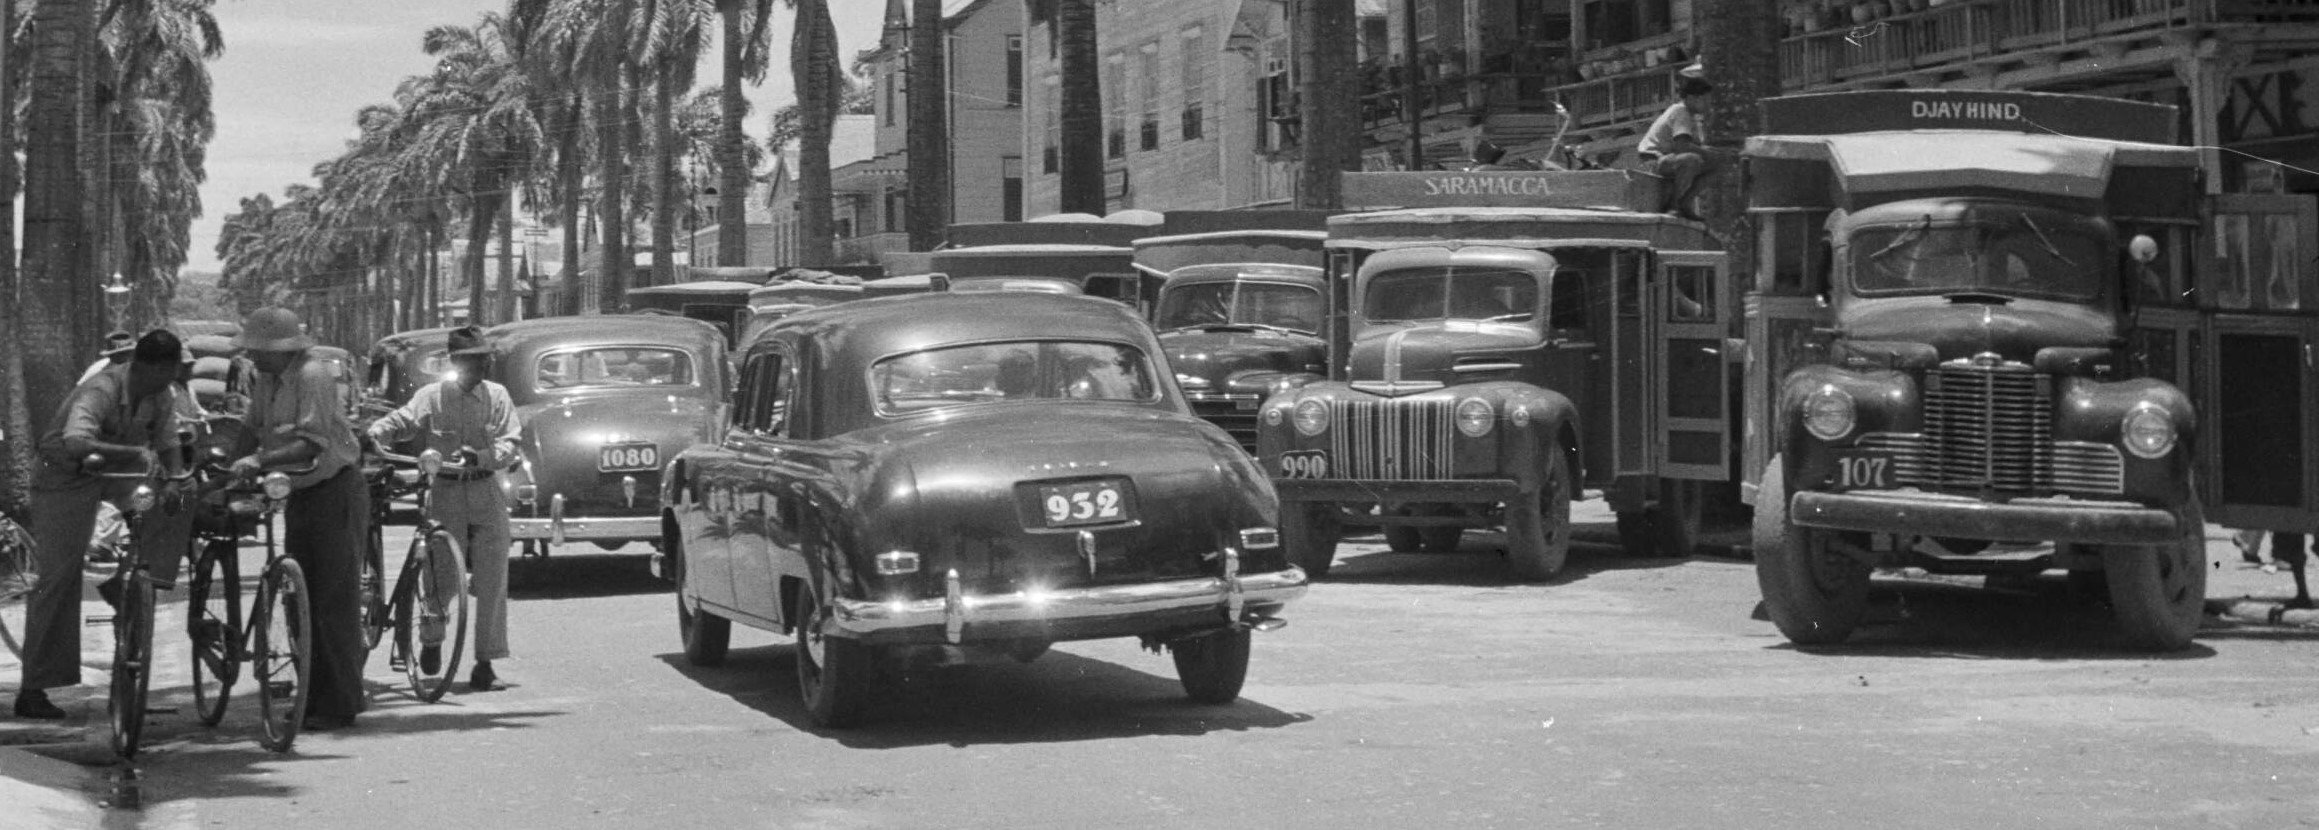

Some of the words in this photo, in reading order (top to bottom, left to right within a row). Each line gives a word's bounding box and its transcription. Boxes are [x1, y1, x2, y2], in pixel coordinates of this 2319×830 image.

[1425, 176, 1553, 196] SARAMACCA
[602, 447, 656, 467] 1080
[1282, 455, 1326, 480] 990
[1838, 457, 1887, 487] 107
[1046, 488, 1119, 522] 932
